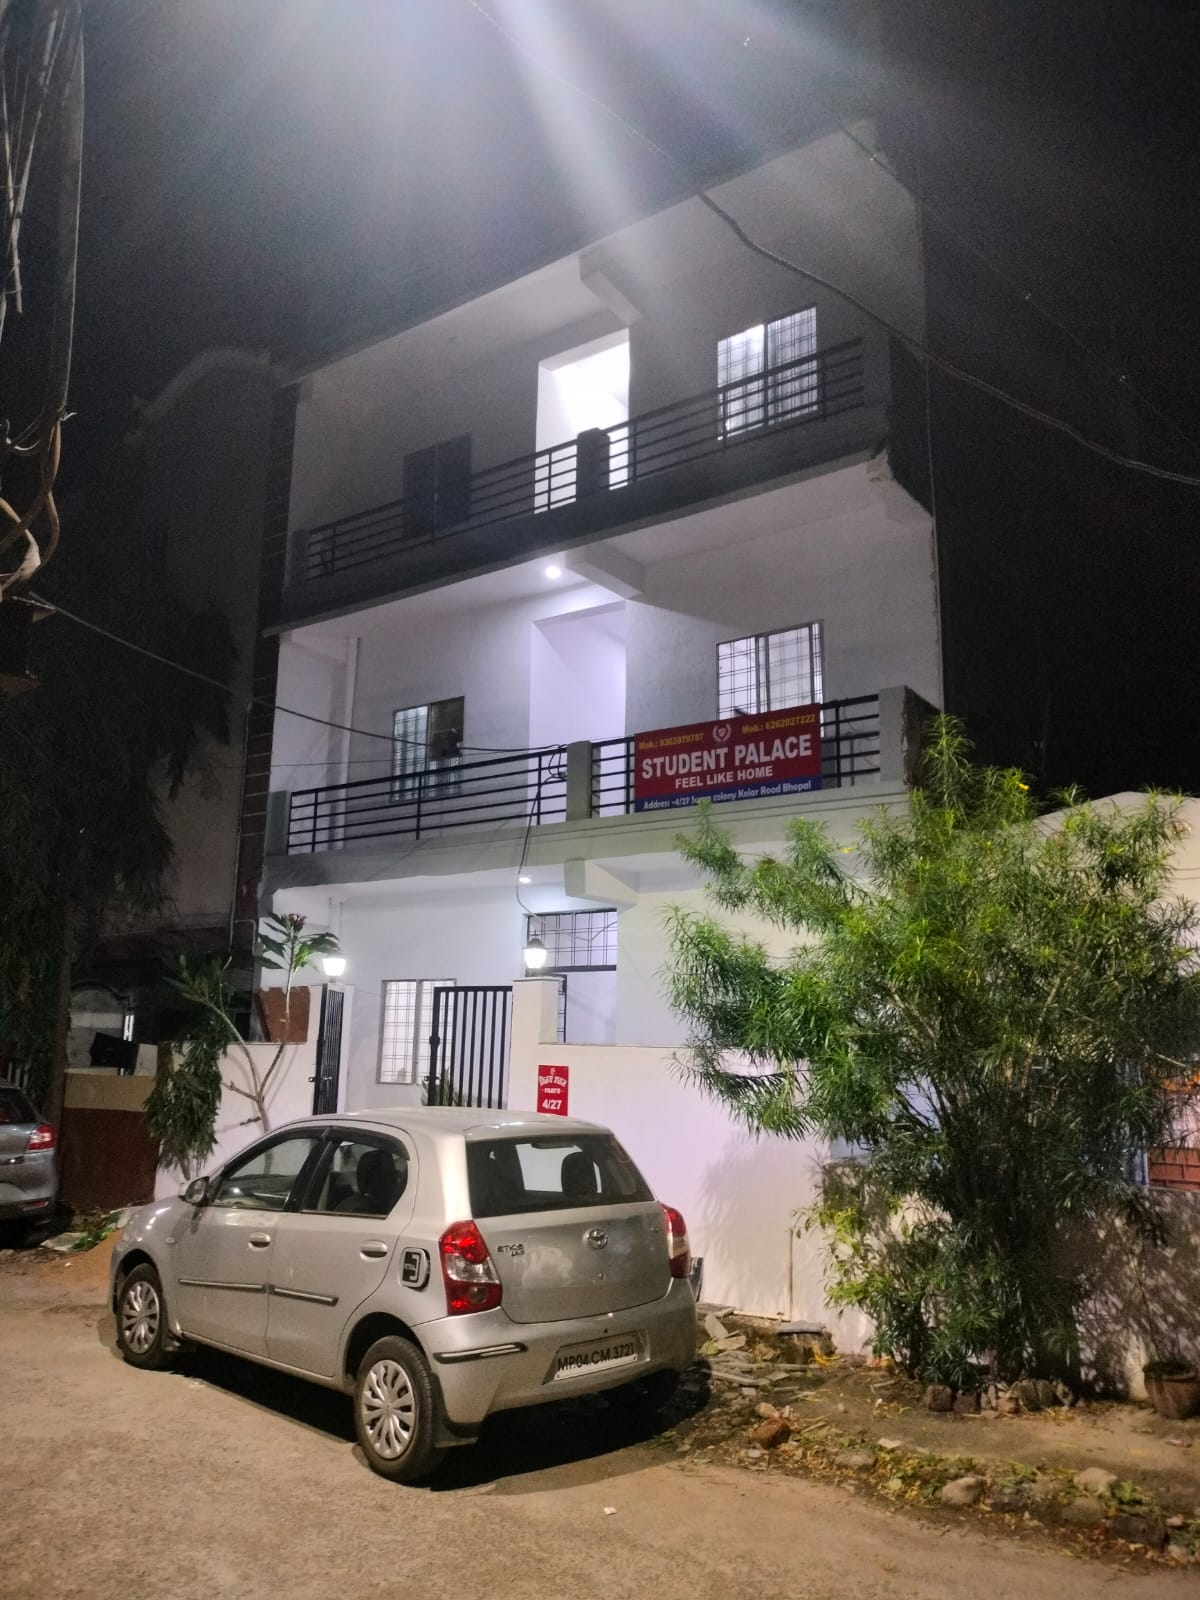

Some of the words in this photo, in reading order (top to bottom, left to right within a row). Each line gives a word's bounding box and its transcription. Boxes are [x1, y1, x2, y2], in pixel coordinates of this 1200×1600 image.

[642, 748, 729, 779] STUDENT
[734, 734, 812, 766] PALACE
[675, 776, 704, 789] FEEL
[706, 772, 734, 785] LIKE
[737, 765, 773, 781] HOME
[713, 792, 736, 801] colony
[738, 788, 760, 799] Kolar
[760, 783, 781, 795] Road
[782, 780, 812, 793] Bhopal
[542, 1099, 562, 1110] 4/27
